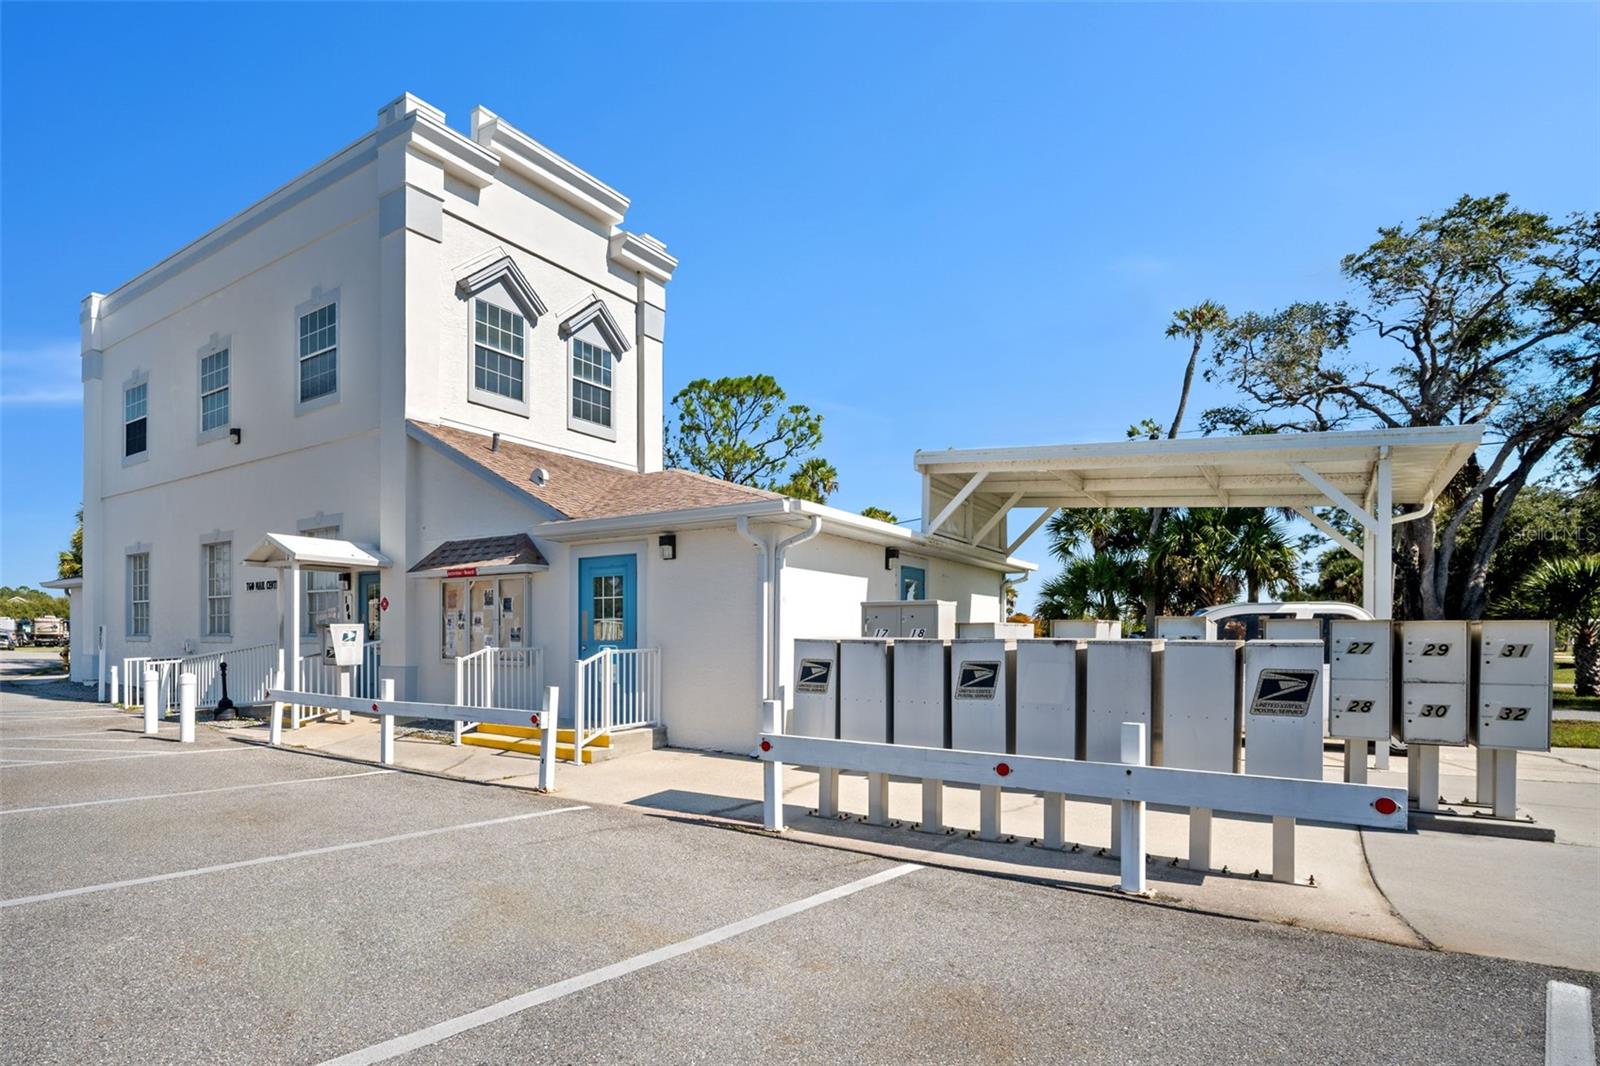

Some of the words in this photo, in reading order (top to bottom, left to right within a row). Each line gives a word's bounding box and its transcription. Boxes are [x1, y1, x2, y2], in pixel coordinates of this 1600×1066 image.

[875, 629, 889, 638] 17
[911, 628, 925, 638] 18
[1346, 642, 1374, 655] 27
[1422, 644, 1449, 656] 29
[1502, 644, 1528, 657] 31
[1346, 700, 1374, 713] 28
[1421, 705, 1448, 718] 30
[1499, 707, 1527, 721] 32
